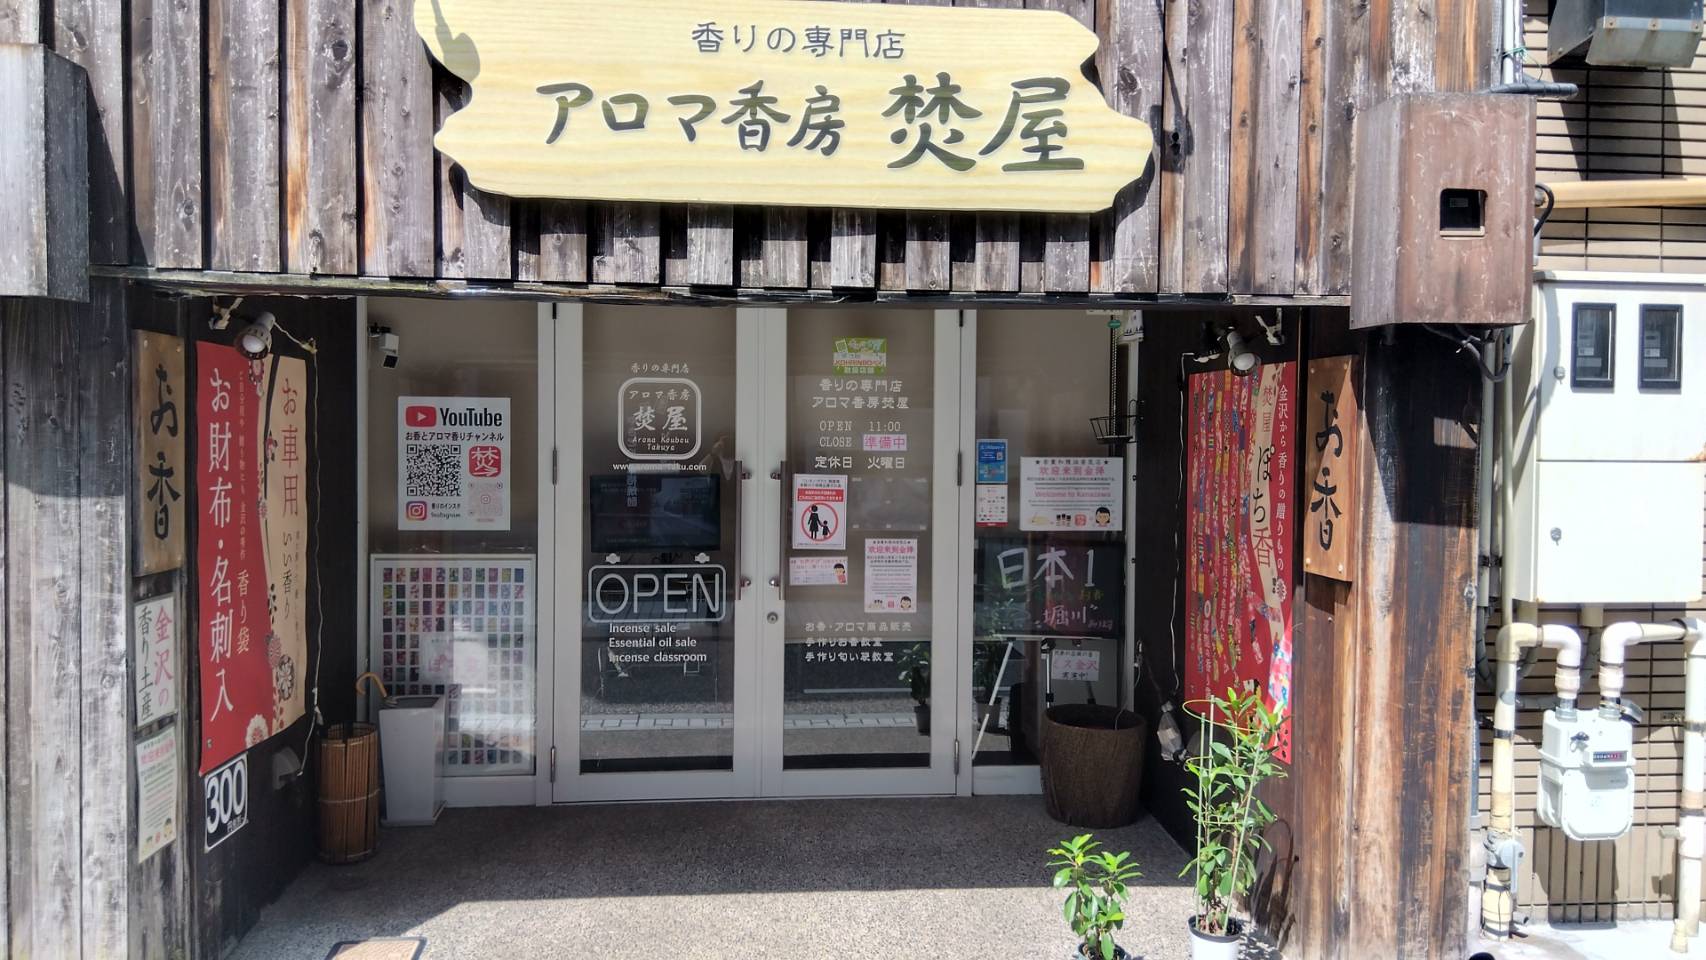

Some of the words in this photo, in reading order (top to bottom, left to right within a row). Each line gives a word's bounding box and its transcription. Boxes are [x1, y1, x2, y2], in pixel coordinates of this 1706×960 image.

[691, 22, 907, 60] 香りの専門店
[535, 79, 847, 156] アロマ香房
[881, 71, 1085, 173] 焚屋
[631, 362, 690, 374] 香りの専門店
[819, 378, 903, 392] 香りの専門店
[629, 388, 690, 401] アロマ香房
[812, 396, 909, 409] アロマ香房焚屋
[440, 408, 503, 427] YouTube
[633, 406, 688, 431] 焚屋
[819, 420, 853, 432] OPEN
[869, 421, 901, 432] 11:00
[405, 431, 504, 442] お香とアロマ香りチャンネル
[819, 436, 853, 448] CLOSE
[864, 436, 905, 449] 準備中
[147, 363, 181, 541] お香
[281, 377, 299, 518] お車用
[814, 456, 853, 469] 定休日
[867, 456, 905, 469] 火曜日
[1311, 389, 1343, 552] お香
[208, 367, 234, 722] お財布・名刺入
[595, 572, 720, 615] OPEN
[236, 569, 250, 655] 香り袋
[609, 622, 651, 633] Incense
[654, 622, 677, 633] sale
[805, 621, 912, 632] お香・アロマ商品販売
[608, 637, 656, 648] Essential
[658, 637, 672, 648] oil
[675, 637, 697, 648] sale
[805, 637, 883, 647] 手作りお香教室
[138, 605, 154, 720] 香り土産
[154, 606, 174, 707] 金沢の
[653, 652, 707, 663] classroom
[206, 759, 246, 834] 300
